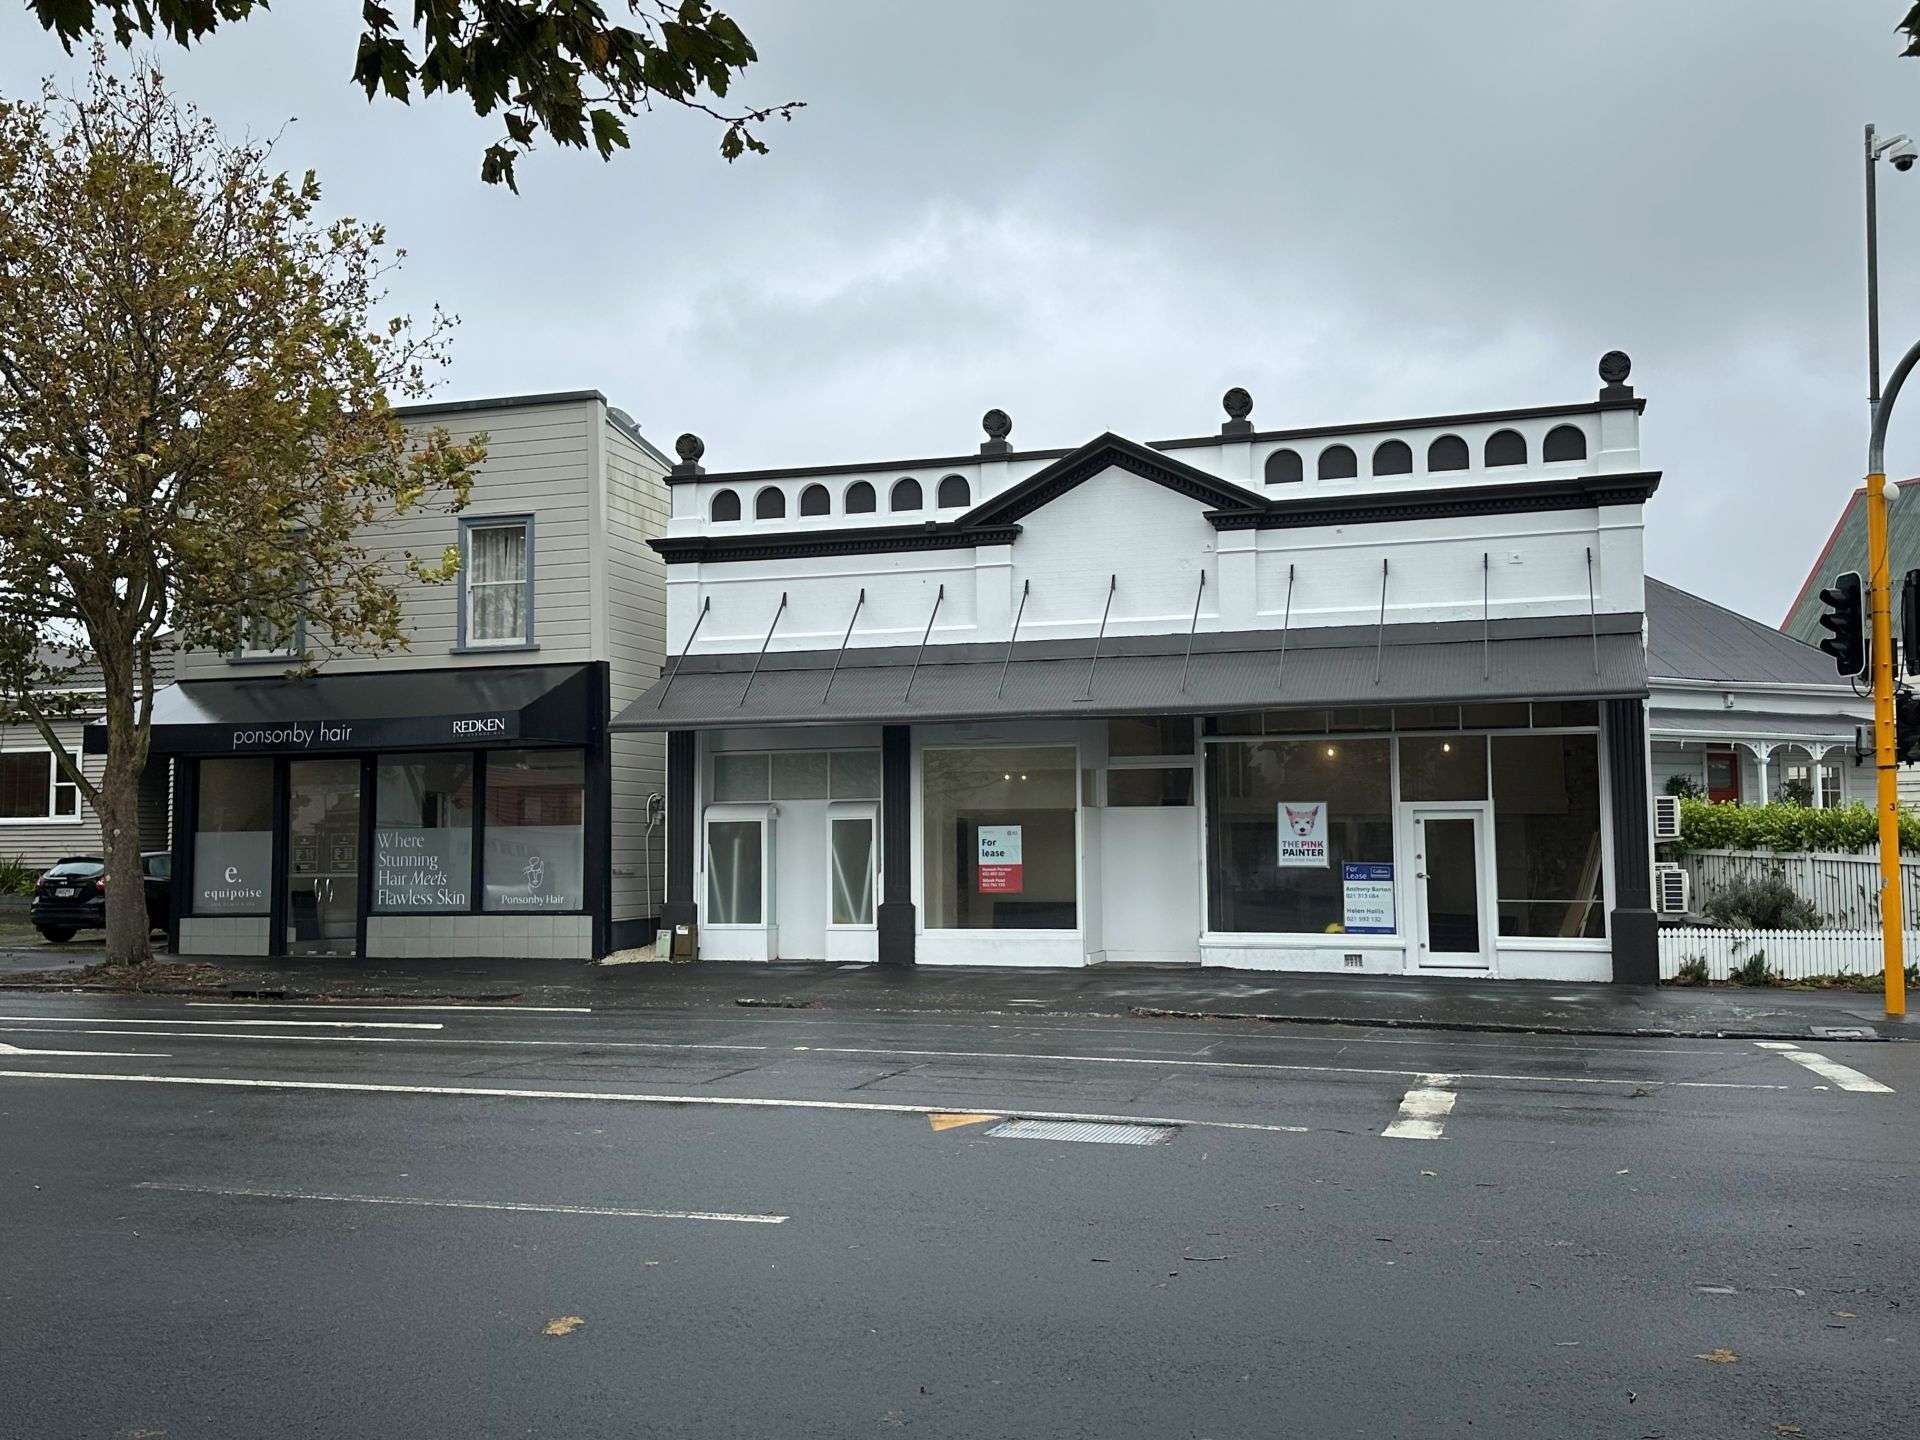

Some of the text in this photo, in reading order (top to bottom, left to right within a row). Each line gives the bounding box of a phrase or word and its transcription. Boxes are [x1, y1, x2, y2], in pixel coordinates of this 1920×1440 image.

[453, 718, 505, 733] REDKEN
[233, 721, 353, 750] ponsonby hair
[1889, 803, 1895, 811] 3
[378, 832, 425, 849] Where
[982, 838, 997, 847] For
[982, 849, 1006, 857] lease
[1282, 849, 1324, 857] PAINTER
[379, 851, 439, 870] Stunning
[225, 866, 242, 883] e.
[1345, 865, 1358, 873] For
[379, 870, 447, 886] Hair Meets
[204, 888, 262, 901] equipoise
[378, 888, 465, 905] Flawless Skin
[501, 894, 564, 906] Ponsonby Hair
